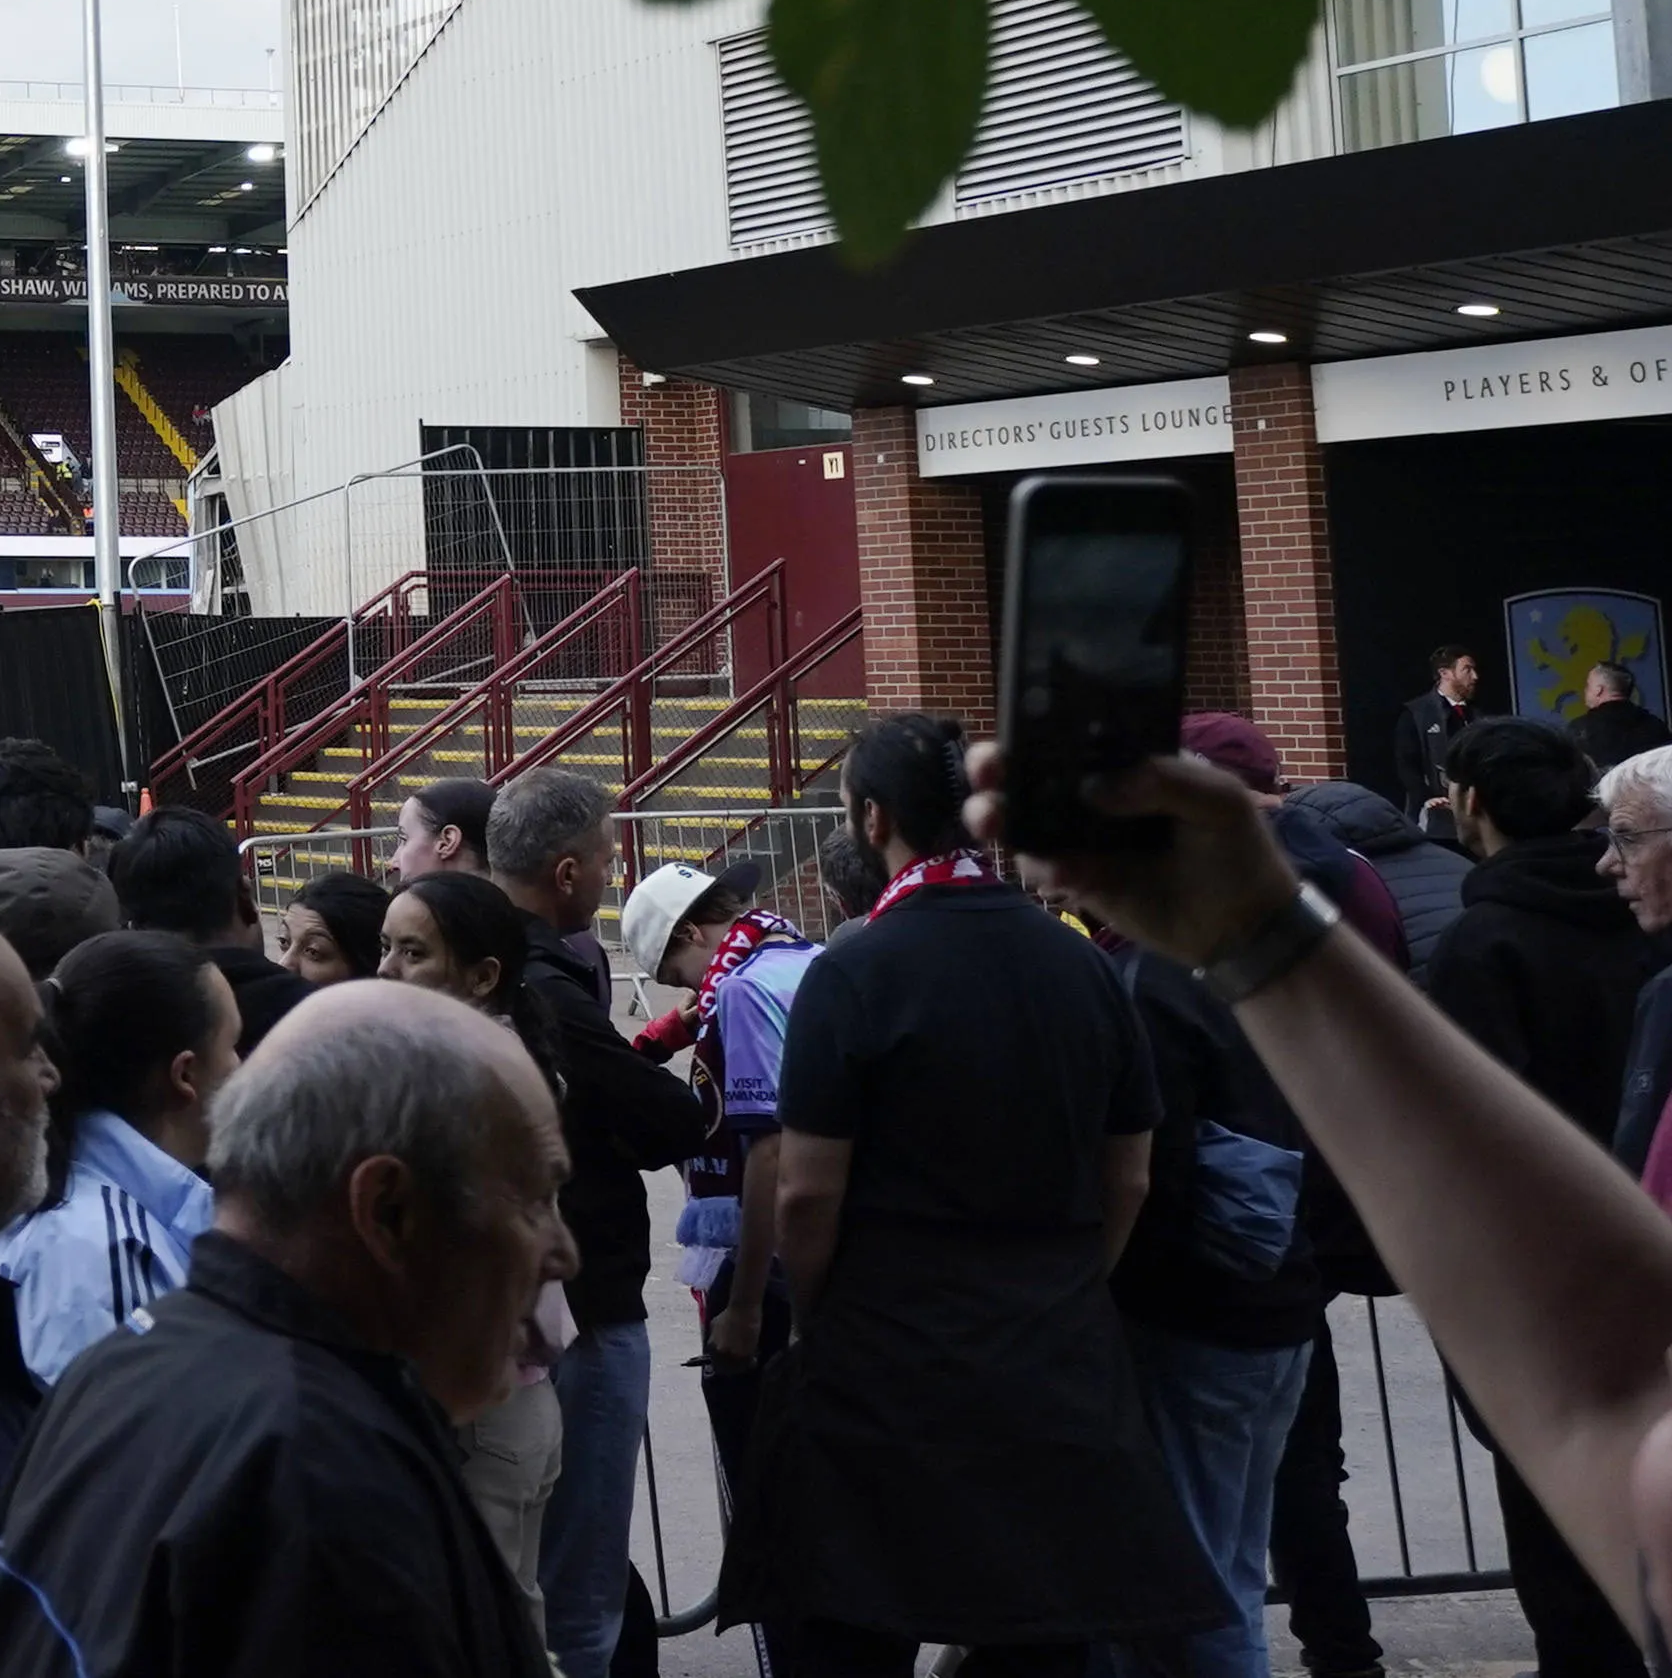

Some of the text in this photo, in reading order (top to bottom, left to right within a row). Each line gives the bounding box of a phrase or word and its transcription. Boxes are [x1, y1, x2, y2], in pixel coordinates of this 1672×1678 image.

[0, 279, 59, 299] SHAW,
[62, 280, 154, 301] WIAMS,
[157, 283, 244, 301] PREPARED
[245, 285, 271, 301] TO
[1444, 358, 1669, 402] PLAYERS & OF
[925, 403, 1233, 453] DIRECTORS' GUESTS LOUNGE
[731, 1077, 763, 1089] VISIT
